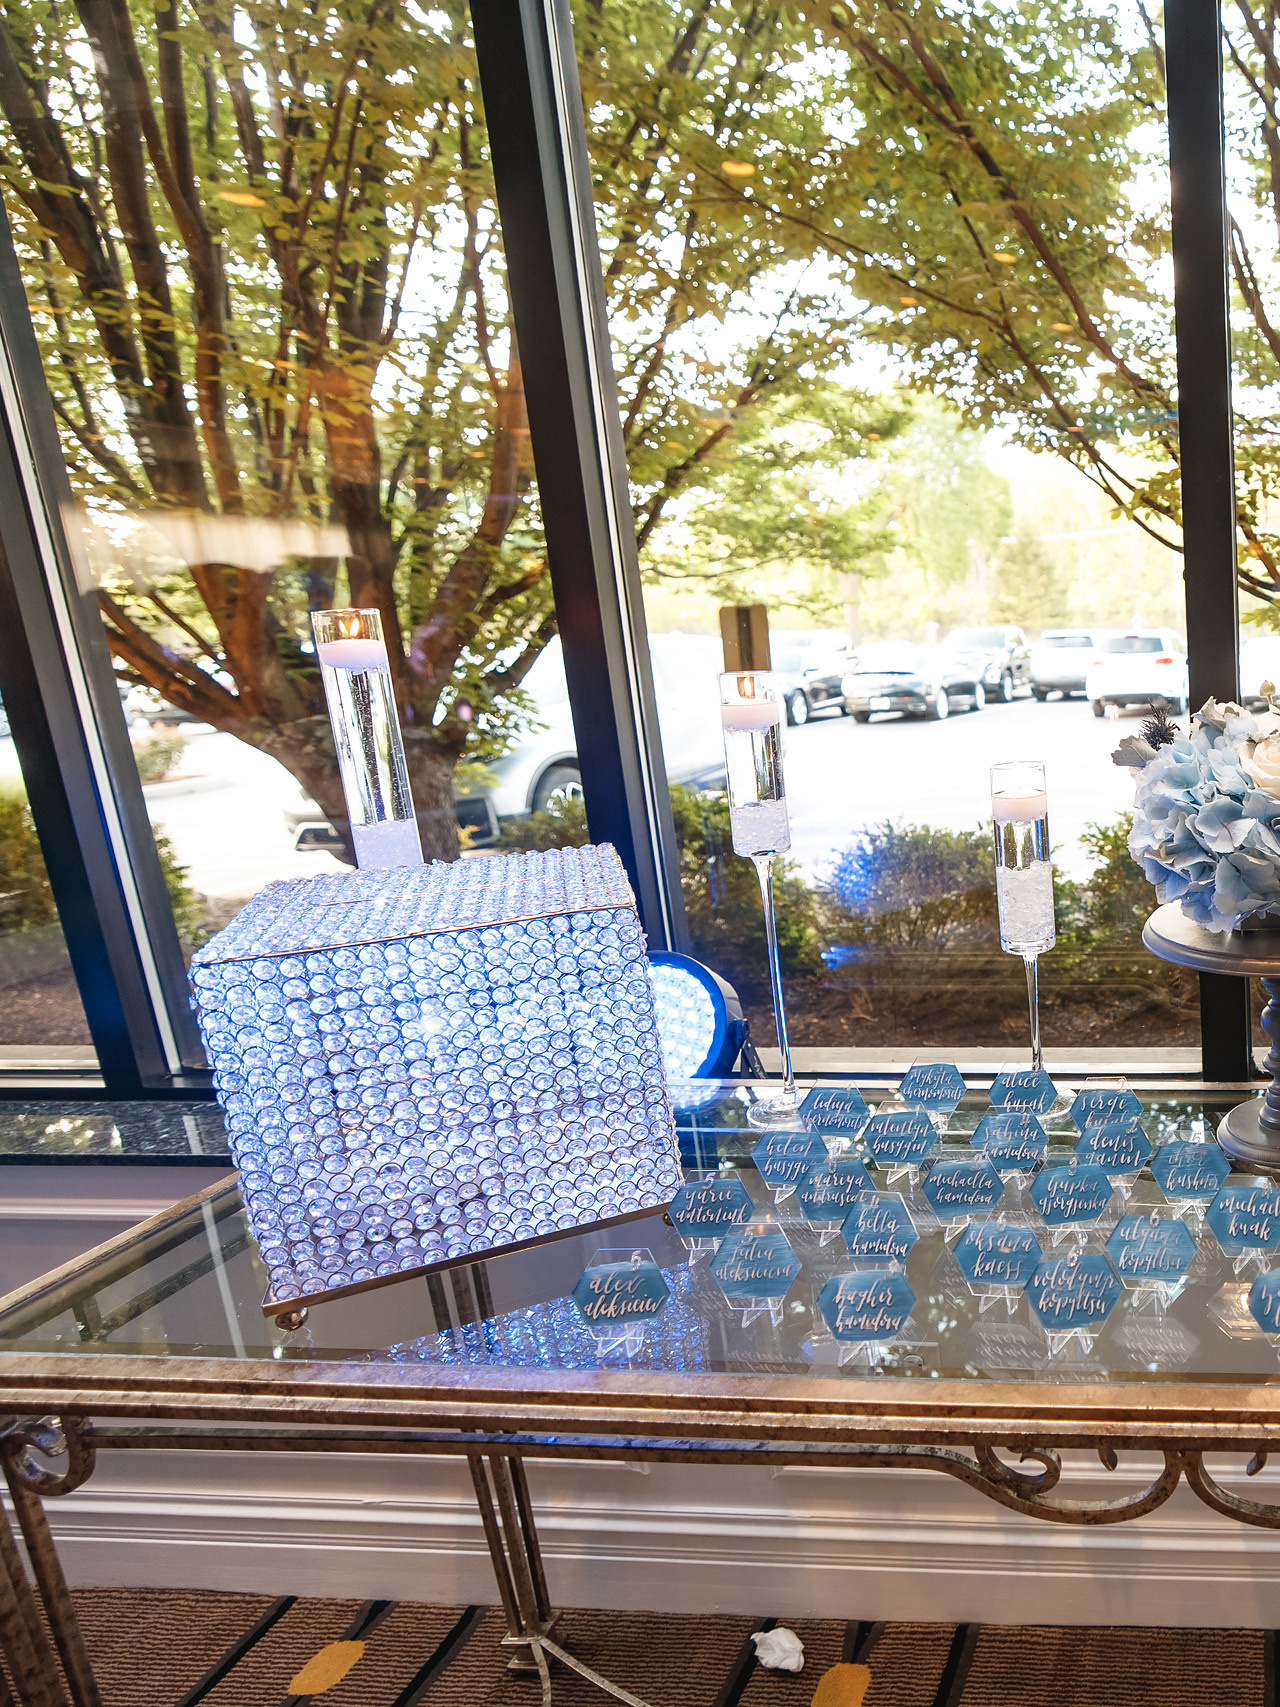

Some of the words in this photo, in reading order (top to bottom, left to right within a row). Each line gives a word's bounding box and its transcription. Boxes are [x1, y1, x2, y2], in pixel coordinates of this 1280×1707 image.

[1001, 1072, 1041, 1088] alice
[766, 1133, 812, 1157] helen
[1090, 1125, 1138, 1153] denis
[701, 1172, 716, 1190] 5
[764, 1158, 813, 1181] busygi
[1150, 1208, 1160, 1228] 6
[630, 1250, 641, 1271] 5
[1067, 1244, 1078, 1268] 6
[589, 1271, 646, 1294] alex
